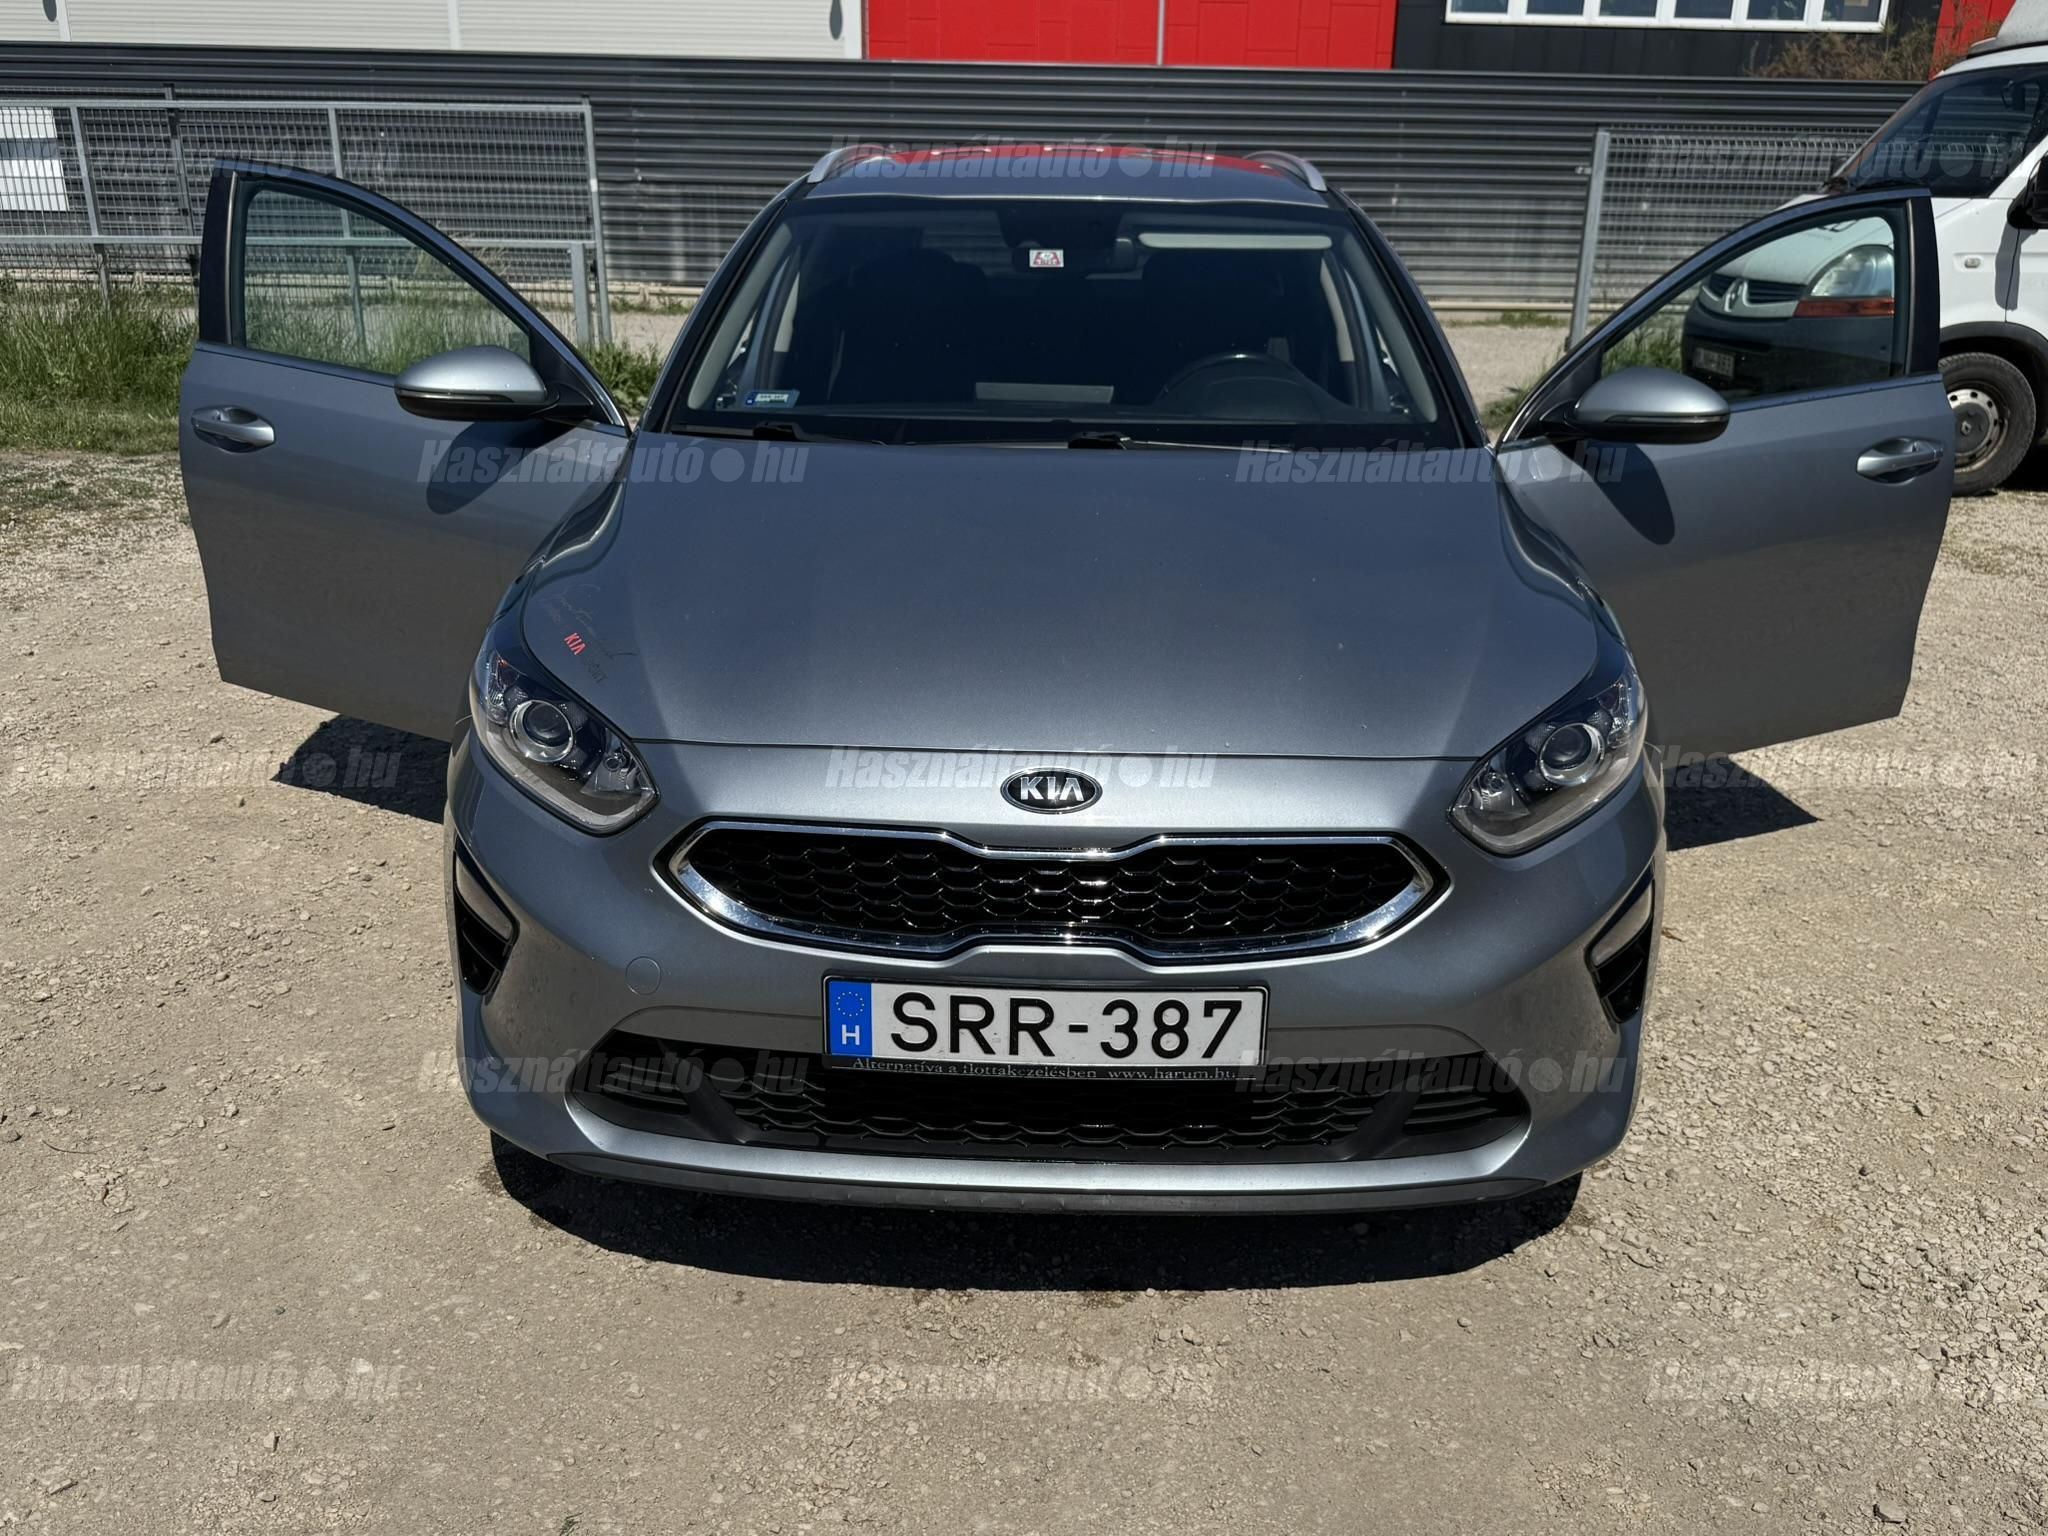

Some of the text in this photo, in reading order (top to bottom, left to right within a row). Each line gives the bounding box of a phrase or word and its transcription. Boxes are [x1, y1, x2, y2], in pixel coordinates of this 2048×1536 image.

[563, 632, 586, 655] KIA
[1020, 776, 1084, 801] KIA
[841, 1024, 860, 1045] H
[890, 991, 1243, 1059] SRR-387
[852, 1057, 944, 1073] Alternatíva
[948, 1065, 957, 1073] a
